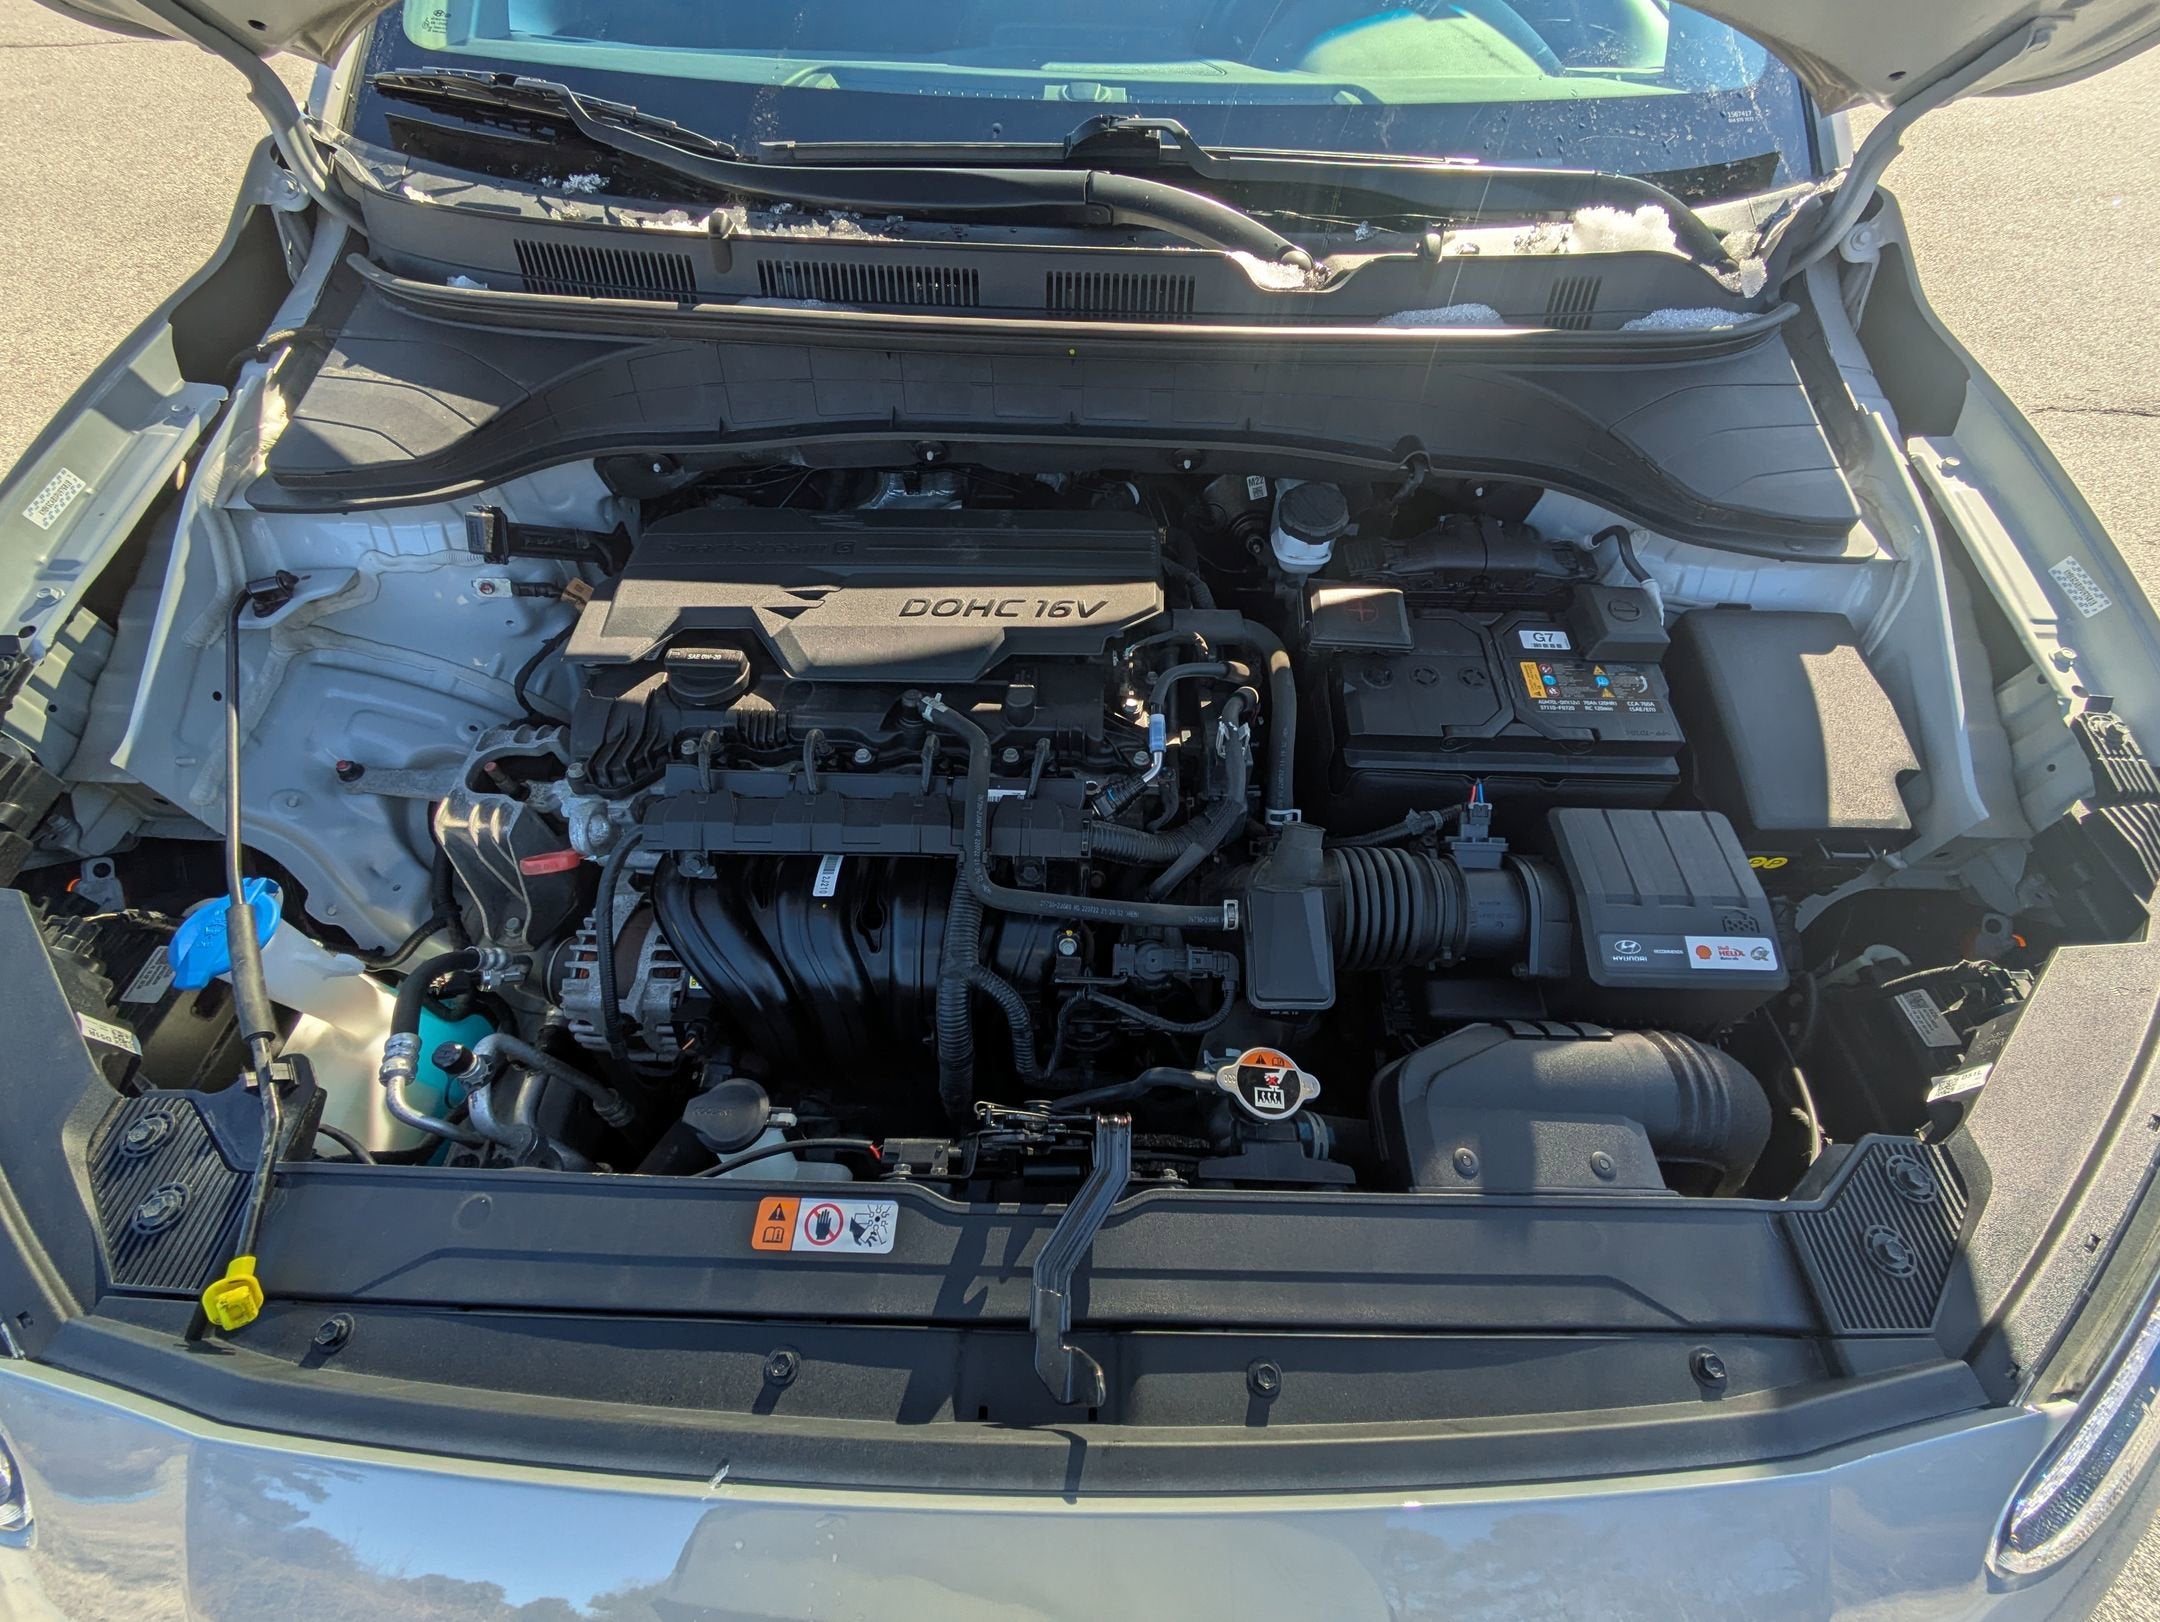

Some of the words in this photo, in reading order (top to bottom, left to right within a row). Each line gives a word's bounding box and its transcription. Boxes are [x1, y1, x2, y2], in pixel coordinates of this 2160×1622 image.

[1248, 476, 1264, 487] M22
[898, 597, 1027, 619] DOHC
[1034, 597, 1109, 620] 16V
[1532, 632, 1554, 643] G7
[818, 876, 830, 894] 2J210
